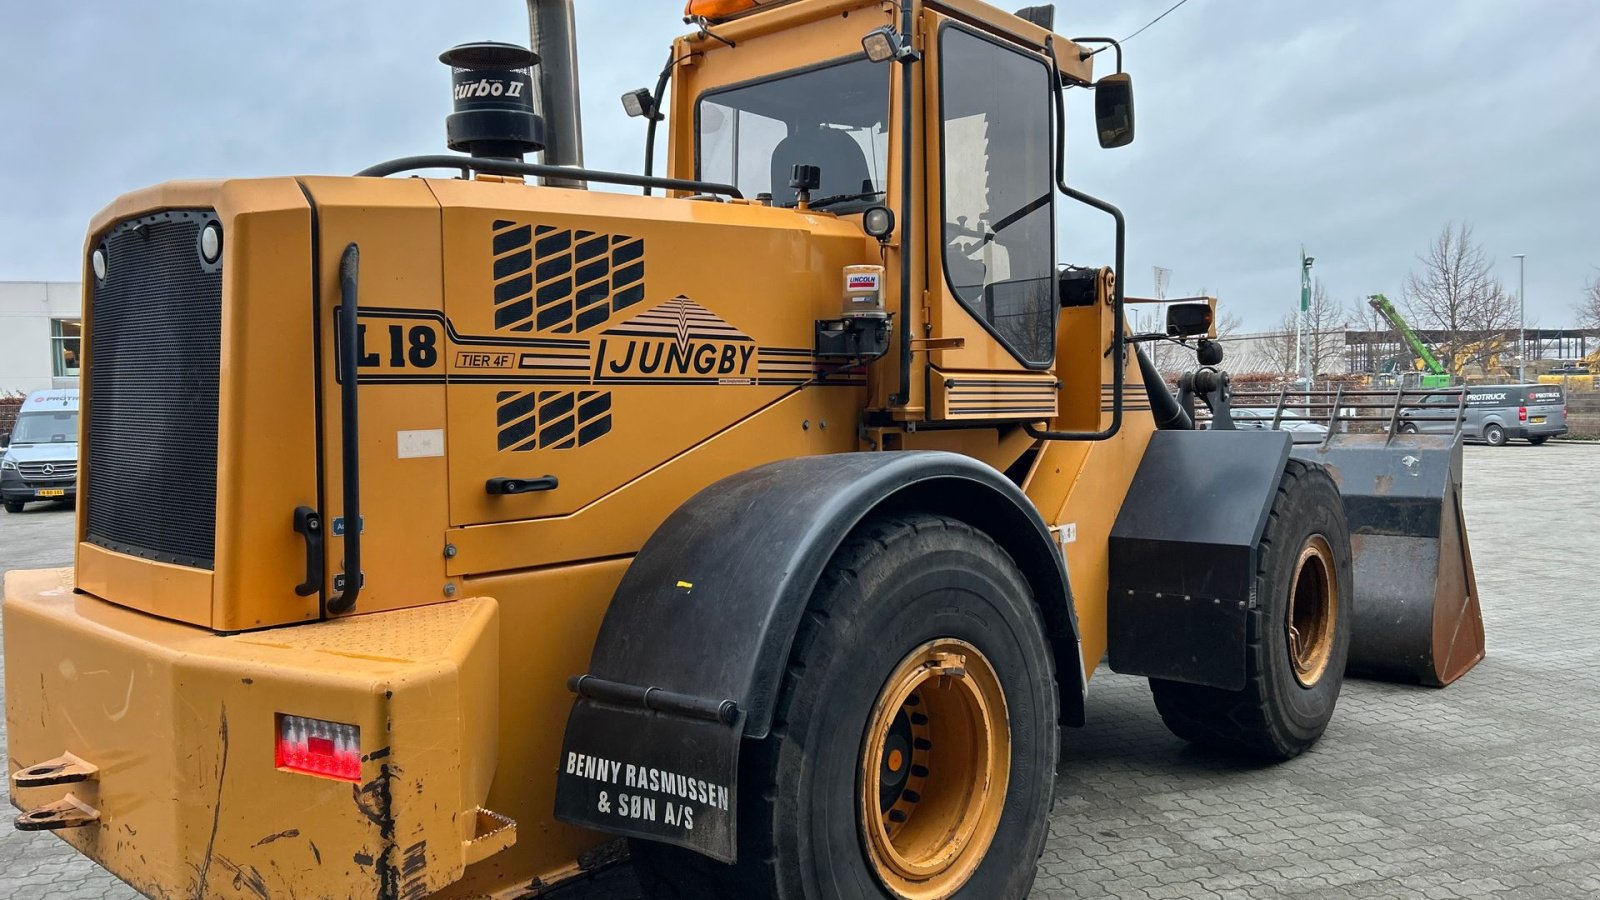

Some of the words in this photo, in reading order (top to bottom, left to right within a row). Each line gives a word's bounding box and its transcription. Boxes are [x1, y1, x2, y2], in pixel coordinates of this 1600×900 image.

[454, 79, 503, 100] turbo
[505, 81, 524, 97] II
[356, 324, 381, 368] L
[389, 325, 438, 369] 18
[462, 354, 491, 367] TIER
[493, 355, 509, 368] 4F
[593, 339, 755, 380] LJUNGBY
[1466, 393, 1506, 401] PROTRUCK
[566, 751, 622, 784] BENNY
[625, 763, 729, 811] RASMUSSEN
[597, 790, 611, 814] &
[618, 793, 656, 822] SØN
[664, 802, 694, 830] A/S
